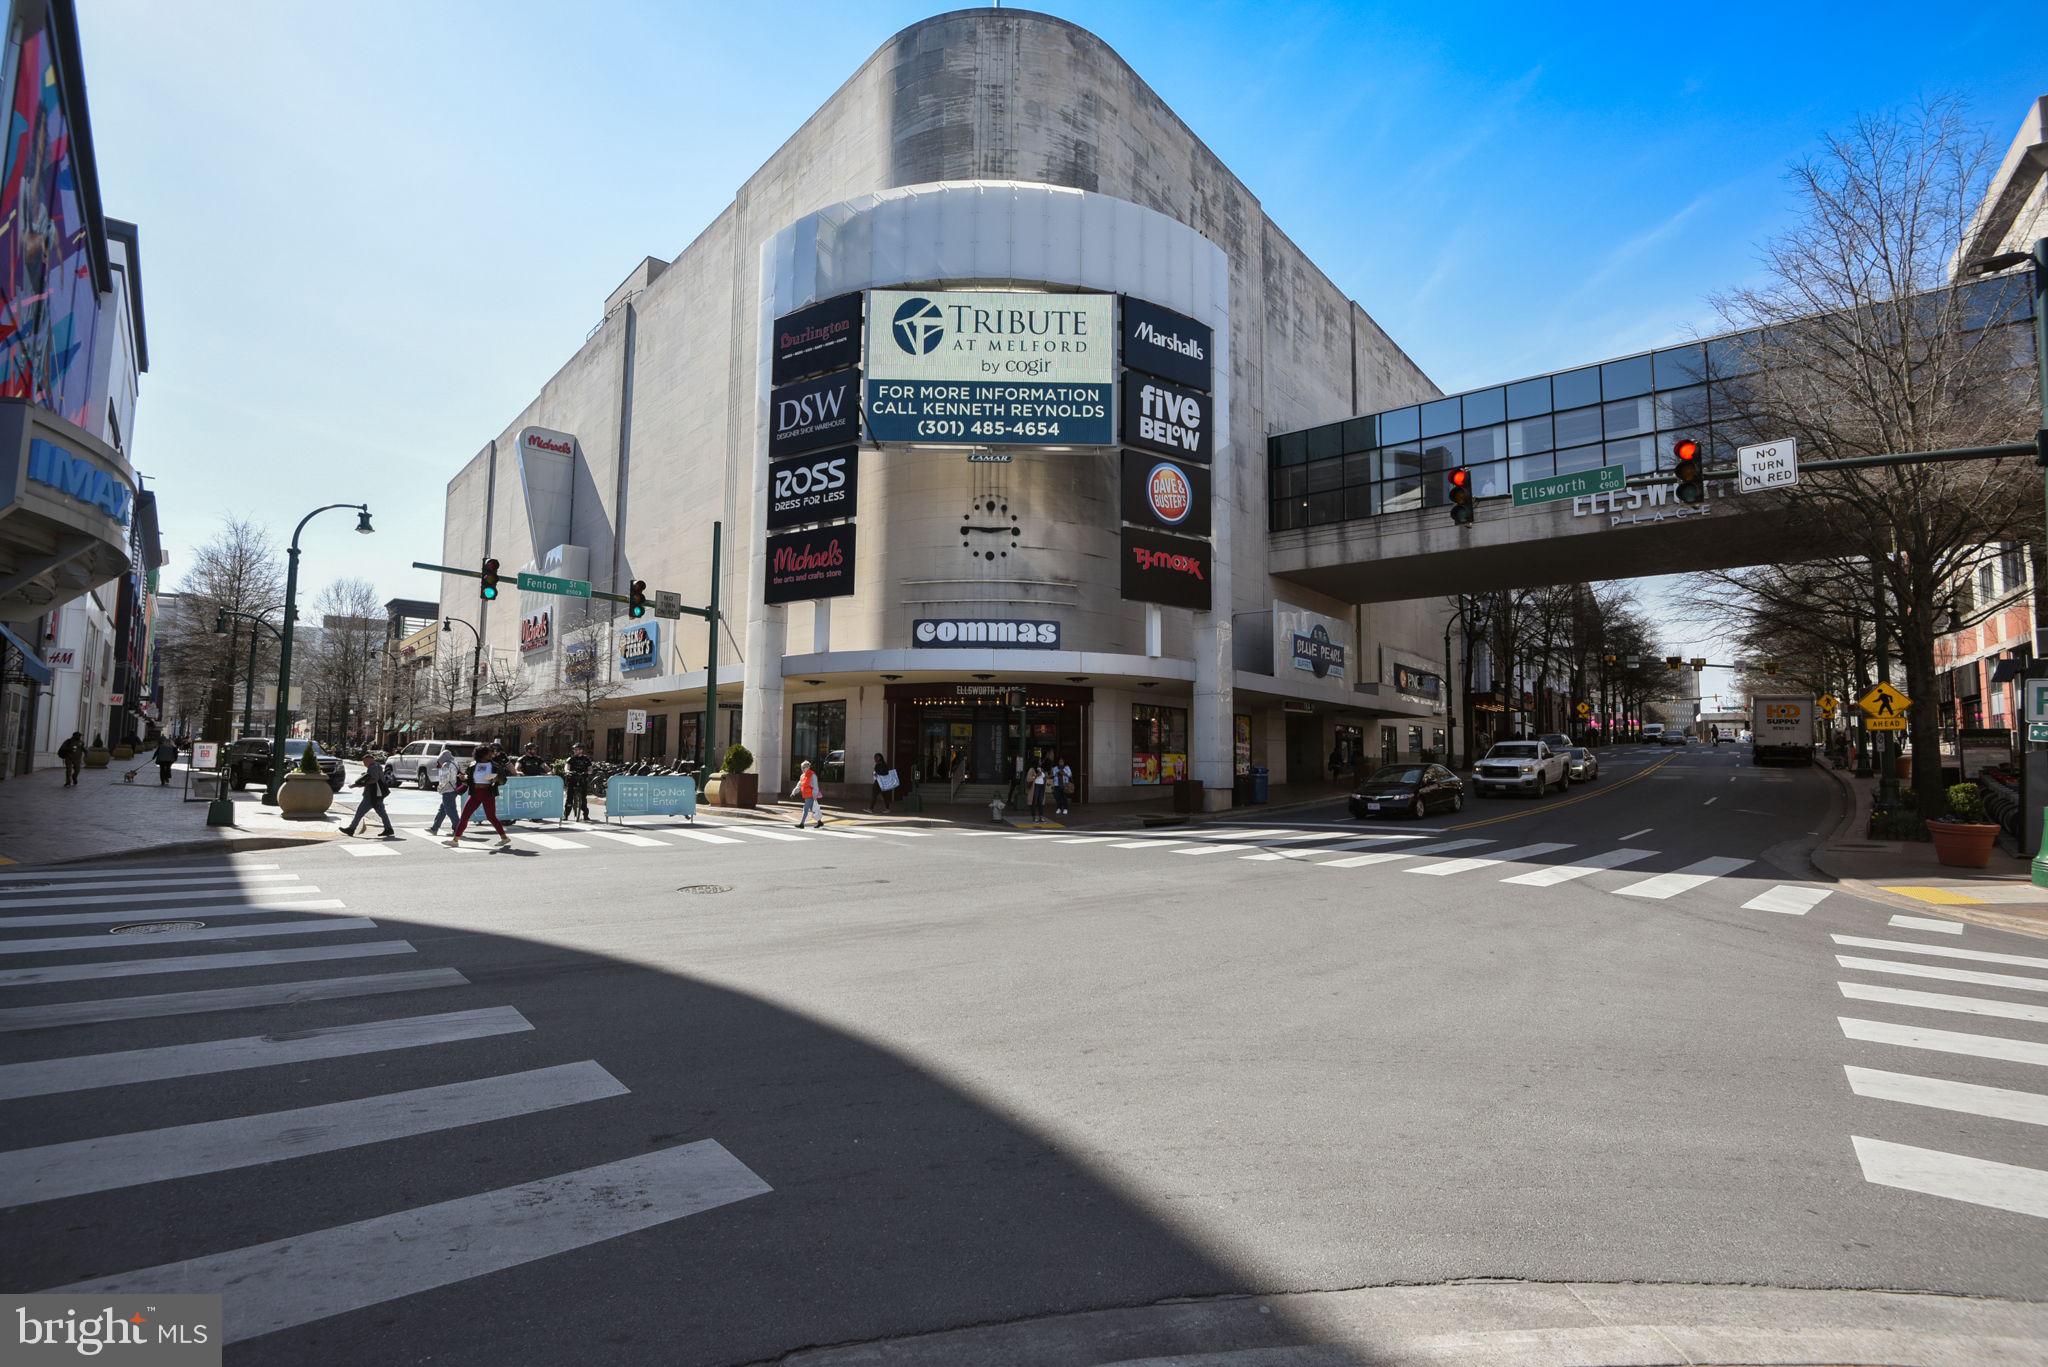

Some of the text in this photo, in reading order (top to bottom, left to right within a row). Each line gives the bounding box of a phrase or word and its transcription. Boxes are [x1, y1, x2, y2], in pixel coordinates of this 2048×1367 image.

[948, 305, 1087, 336] TRIBUTE
[953, 340, 1087, 353] AT MELFORD
[1134, 321, 1204, 360] Marshalls
[981, 358, 1051, 376] by cogir
[879, 386, 1099, 402] FOR MORE INFORMATION
[777, 385, 847, 432] DSW
[872, 402, 1104, 418] CALL KENNETH REYNOLDS
[1140, 384, 1200, 428] five
[917, 420, 1060, 436] (301) 485-4654
[528, 434, 571, 455] Michaels
[1756, 448, 1777, 459] NO
[1751, 459, 1784, 472] TURN
[28, 438, 134, 527] IMAX
[775, 458, 846, 498] ROSS
[1153, 478, 1185, 494] DAVE &
[1521, 471, 1612, 500] Ellsworth Dr
[1744, 470, 1792, 486] ON RED
[775, 490, 845, 512] DRESS FOR LESS
[1154, 494, 1187, 509] BUSTER'S
[1611, 504, 1712, 527] PLACE
[773, 539, 843, 573] Michaels
[526, 578, 557, 590] Fenton
[795, 573, 807, 582] and
[807, 571, 824, 580] crafts
[826, 570, 842, 578] store
[916, 621, 1057, 644] commas
[956, 685, 995, 695] ELLSWORTH
[631, 722, 643, 731] 15
[515, 789, 530, 799] Do
[534, 788, 553, 799] Not
[652, 788, 686, 797] Do Not
[515, 800, 545, 809] Enter
[652, 798, 678, 806] Enter
